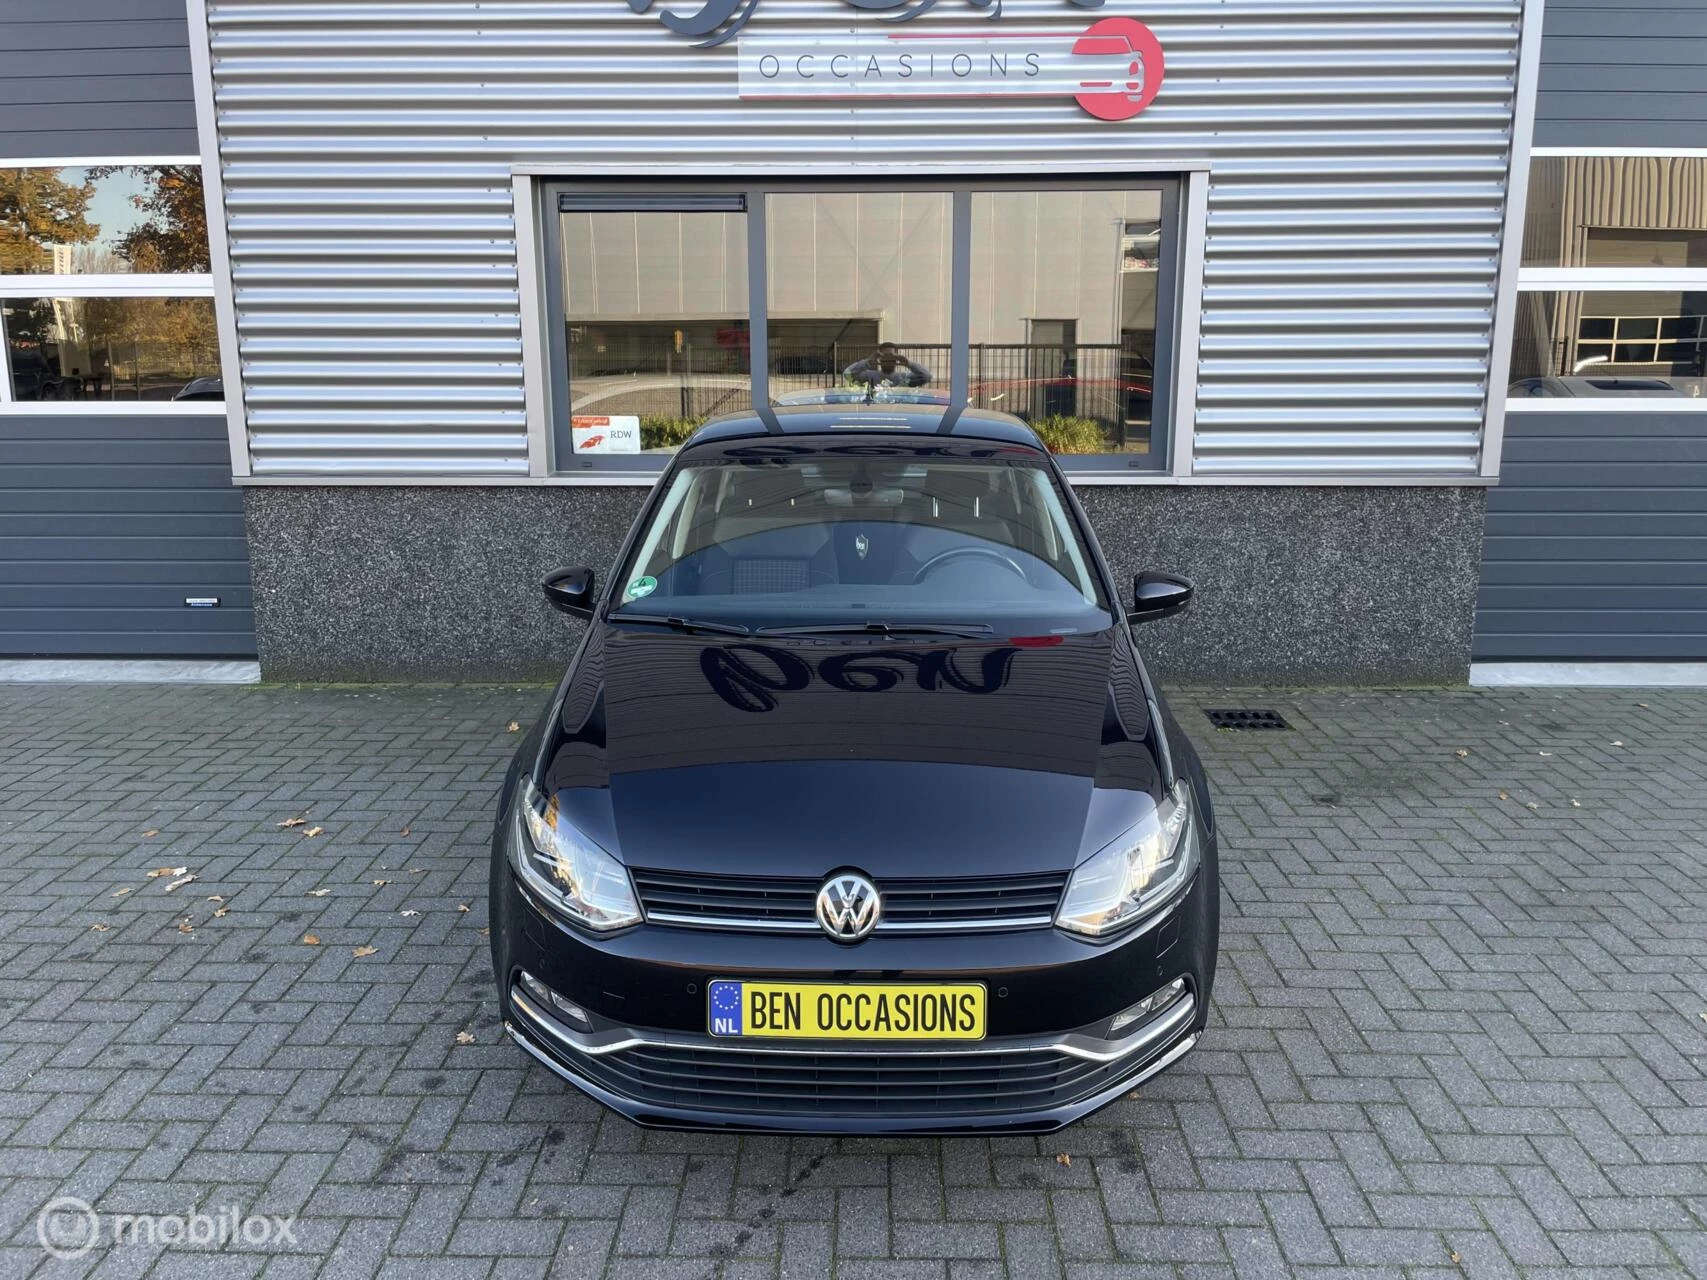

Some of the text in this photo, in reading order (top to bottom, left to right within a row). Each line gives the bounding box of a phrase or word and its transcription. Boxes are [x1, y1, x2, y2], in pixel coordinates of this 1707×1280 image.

[758, 52, 1041, 79] OCCASIONS
[610, 430, 632, 439] RDW
[817, 875, 880, 939] VW
[750, 991, 976, 1032] BEN OCCASIONS
[714, 1017, 738, 1034] NL
